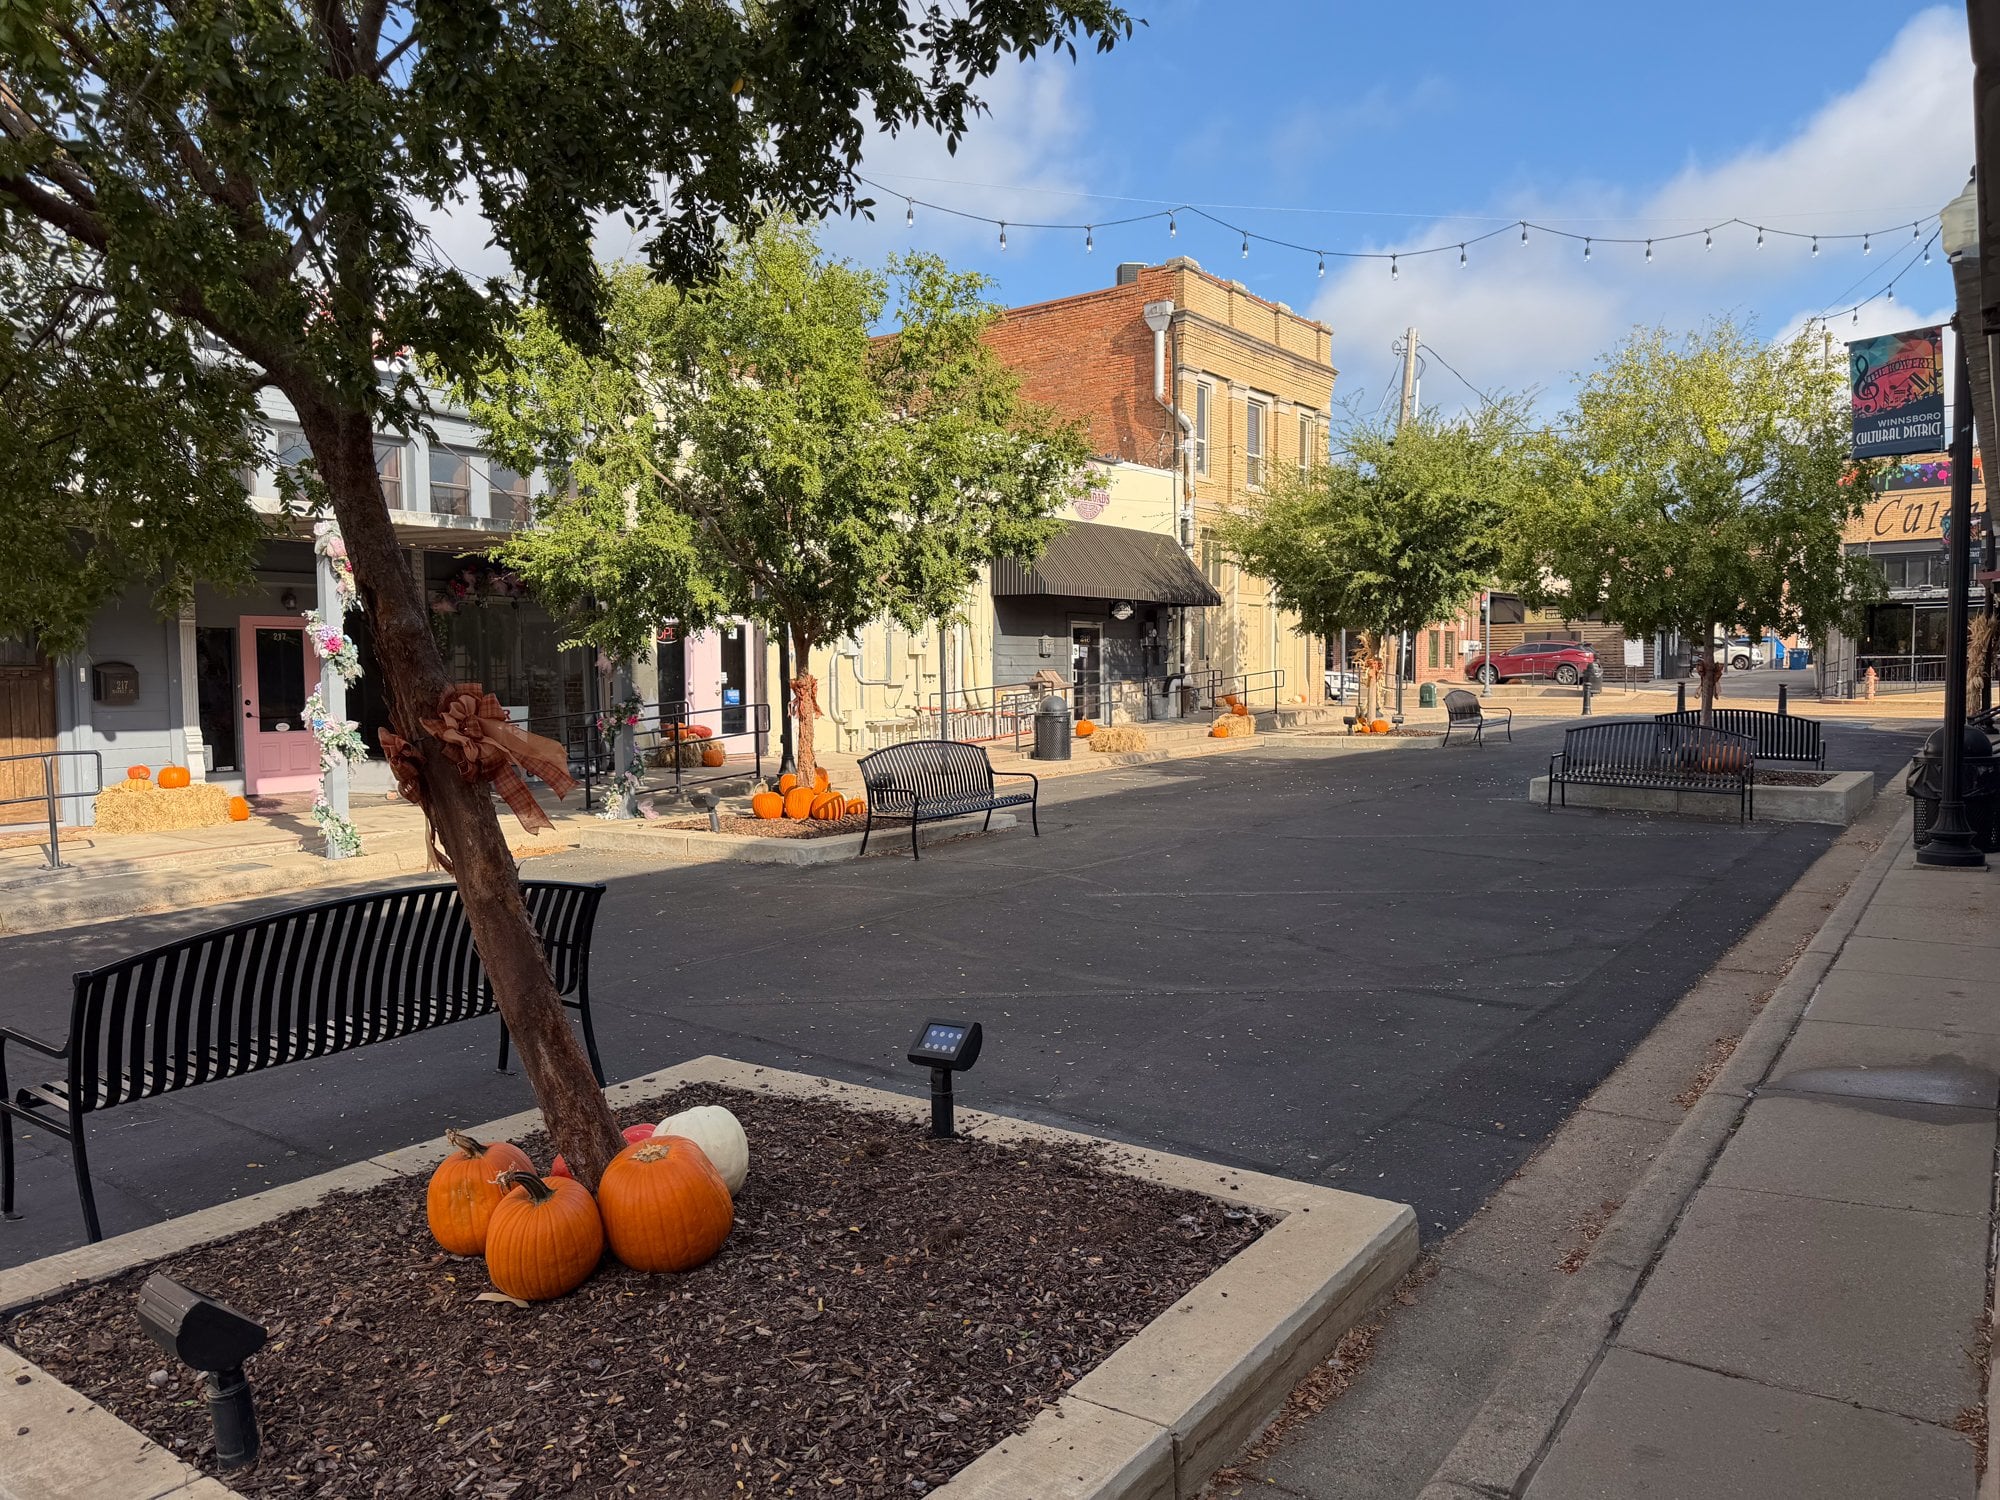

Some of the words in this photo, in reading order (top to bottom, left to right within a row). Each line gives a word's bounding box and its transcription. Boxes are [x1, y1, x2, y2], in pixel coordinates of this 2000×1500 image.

[1866, 367, 1888, 381] THE
[1877, 411, 1942, 428] WINNSBORO
[1855, 426, 1901, 445] CULTURAL
[1903, 421, 1942, 439] DISTRICT
[272, 632, 288, 641] 217
[656, 626, 677, 640] OPE
[116, 680, 129, 690] 217
